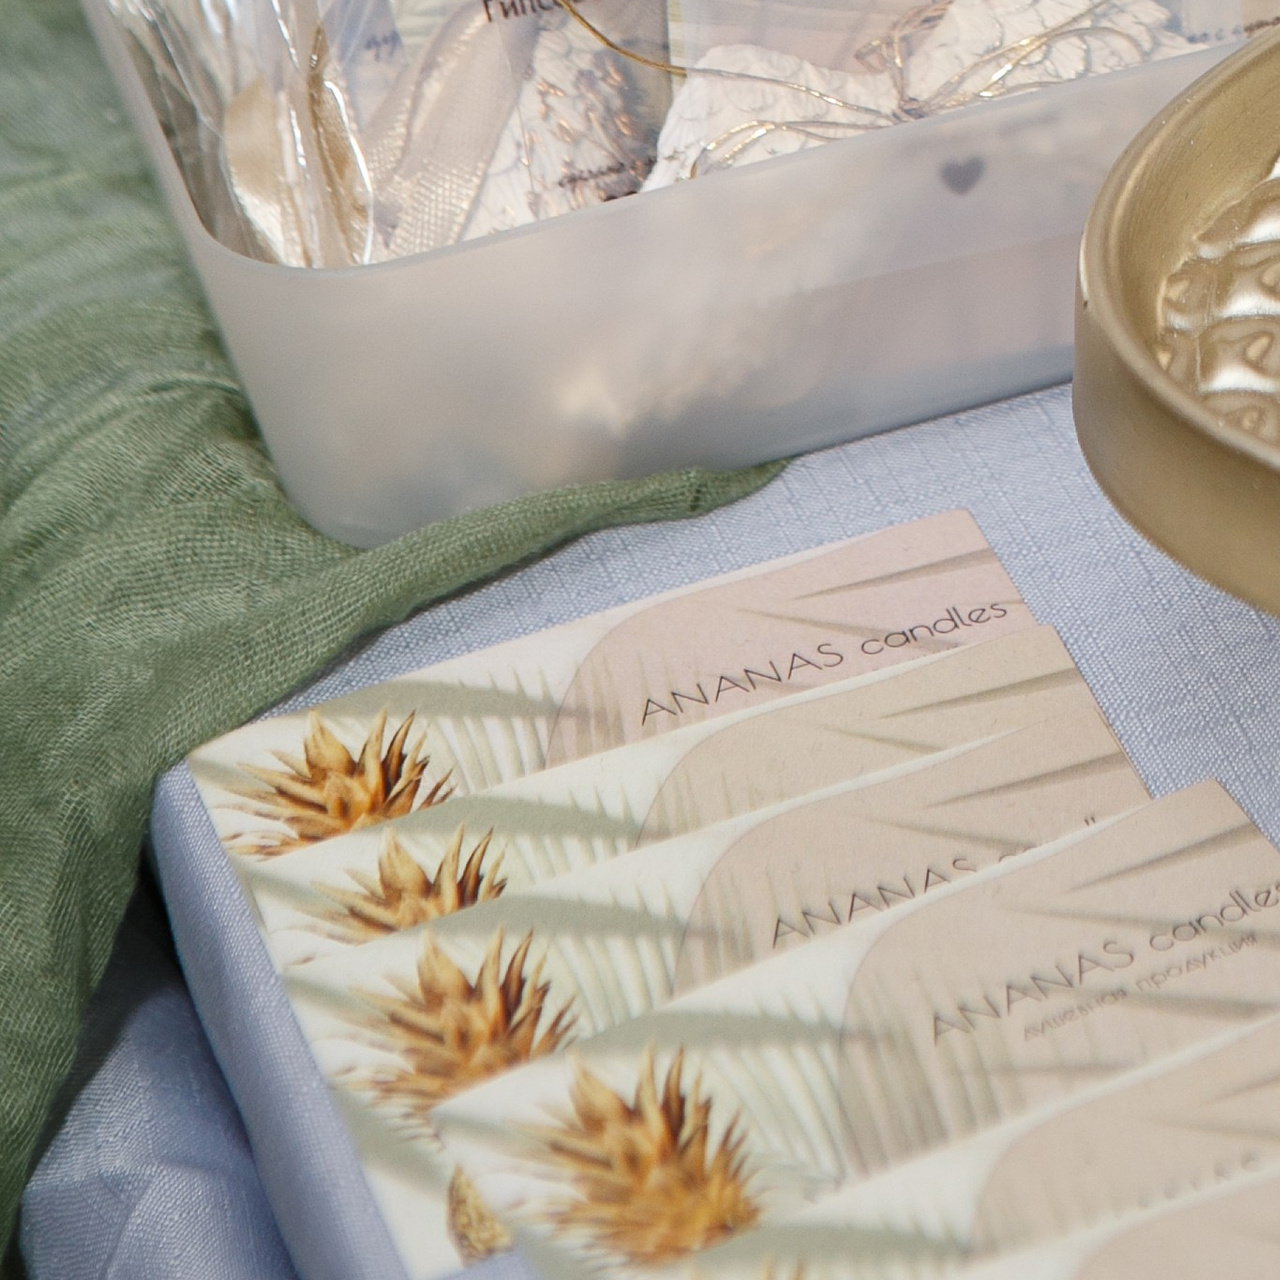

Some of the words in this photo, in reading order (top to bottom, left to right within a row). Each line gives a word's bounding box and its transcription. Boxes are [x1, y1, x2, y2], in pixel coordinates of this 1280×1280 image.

[641, 642, 844, 727] ANANAS
[860, 602, 1008, 655] candles
[933, 940, 1135, 1047] ANANAS
[1135, 933, 1259, 992] продукция
